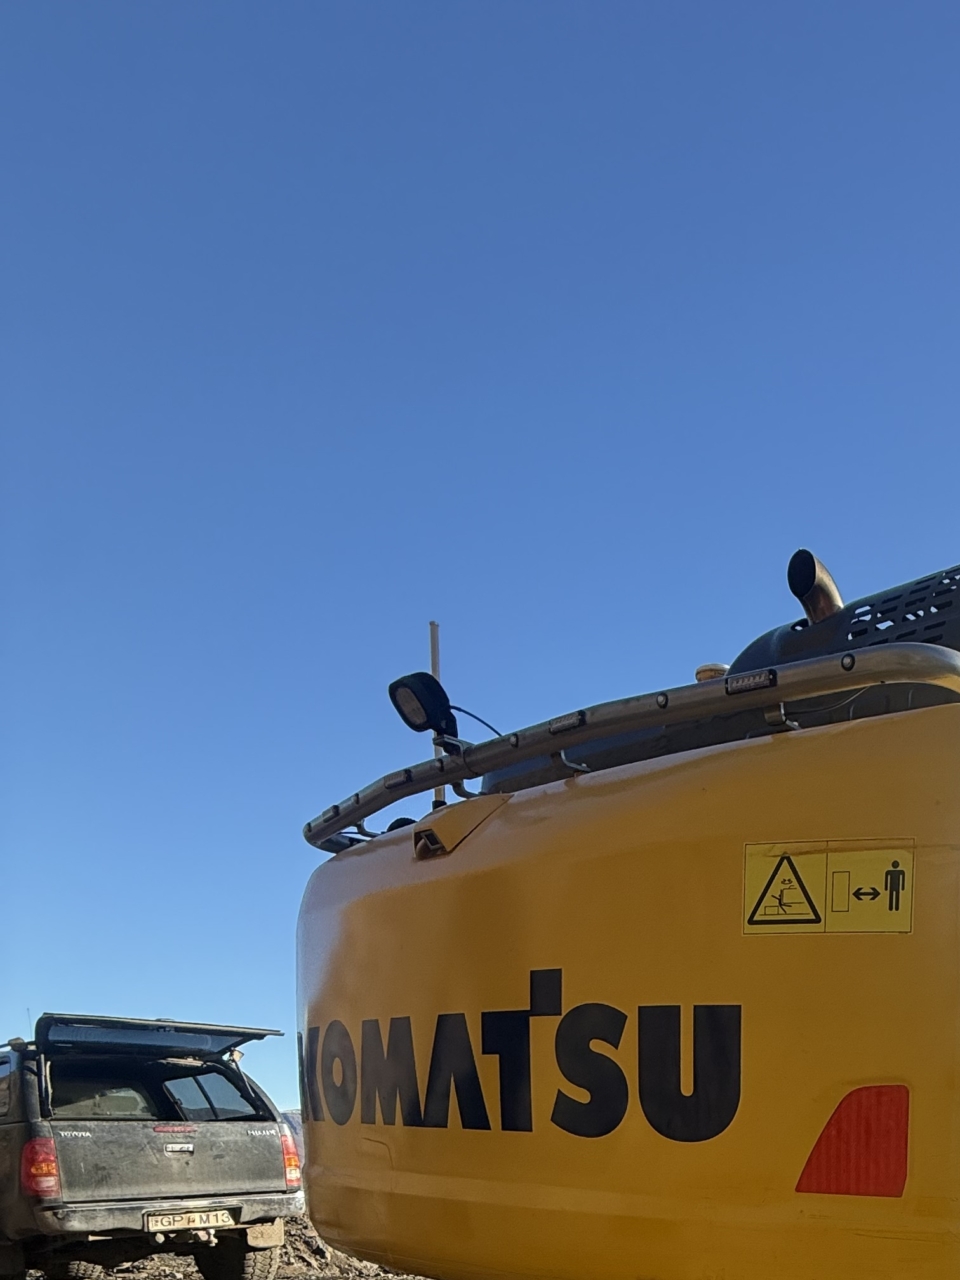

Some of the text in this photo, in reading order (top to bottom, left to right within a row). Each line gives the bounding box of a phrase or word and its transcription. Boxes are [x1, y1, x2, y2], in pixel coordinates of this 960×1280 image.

[300, 968, 742, 1143] KOMATSU
[59, 1130, 92, 1138] TOYOTA
[160, 1215, 184, 1227] GP
[199, 1212, 231, 1225] M13
